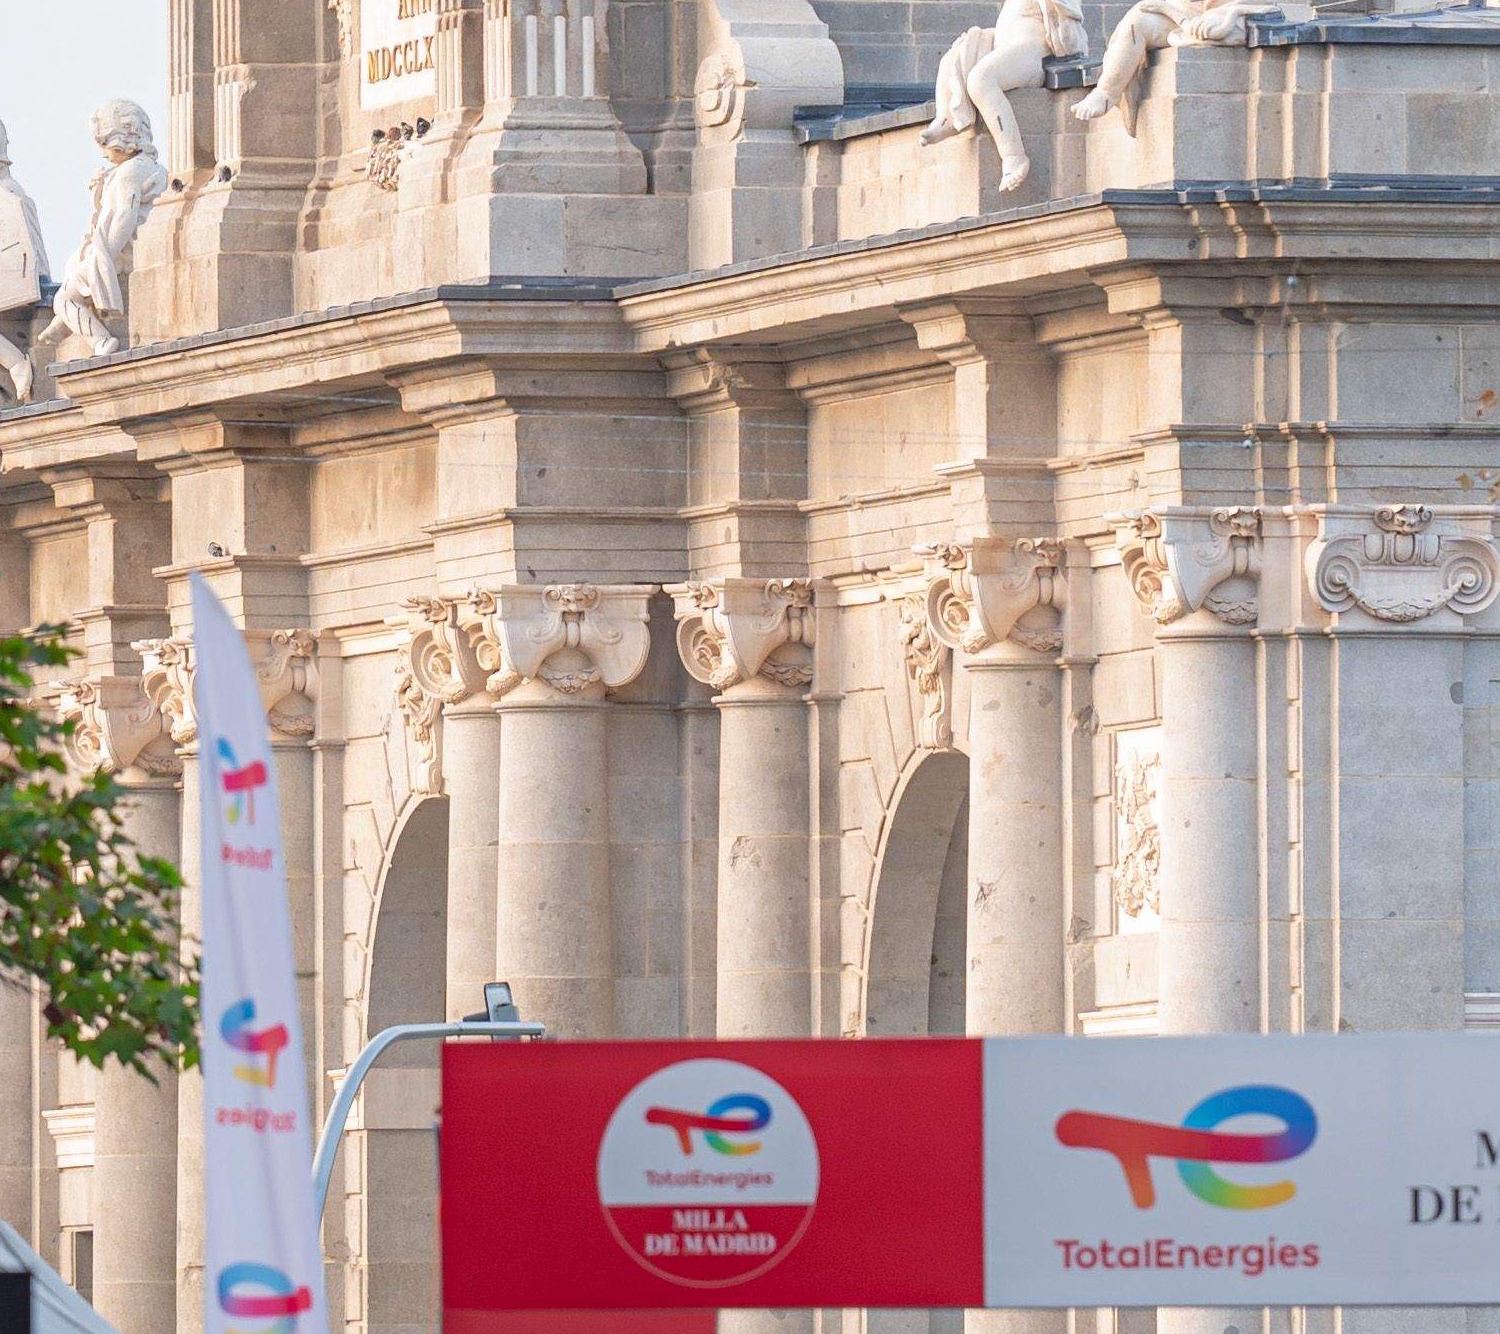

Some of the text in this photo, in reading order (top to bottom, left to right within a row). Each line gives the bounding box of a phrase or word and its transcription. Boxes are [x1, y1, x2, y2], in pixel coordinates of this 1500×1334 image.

[367, 35, 435, 84] MDCCLX
[643, 1168, 775, 1191] TotalEnergies
[671, 1209, 749, 1231] MILLA
[1409, 1185, 1483, 1225] DE
[643, 1233, 778, 1256] DE MADRID
[1053, 1235, 1321, 1276] TotalEnergies
